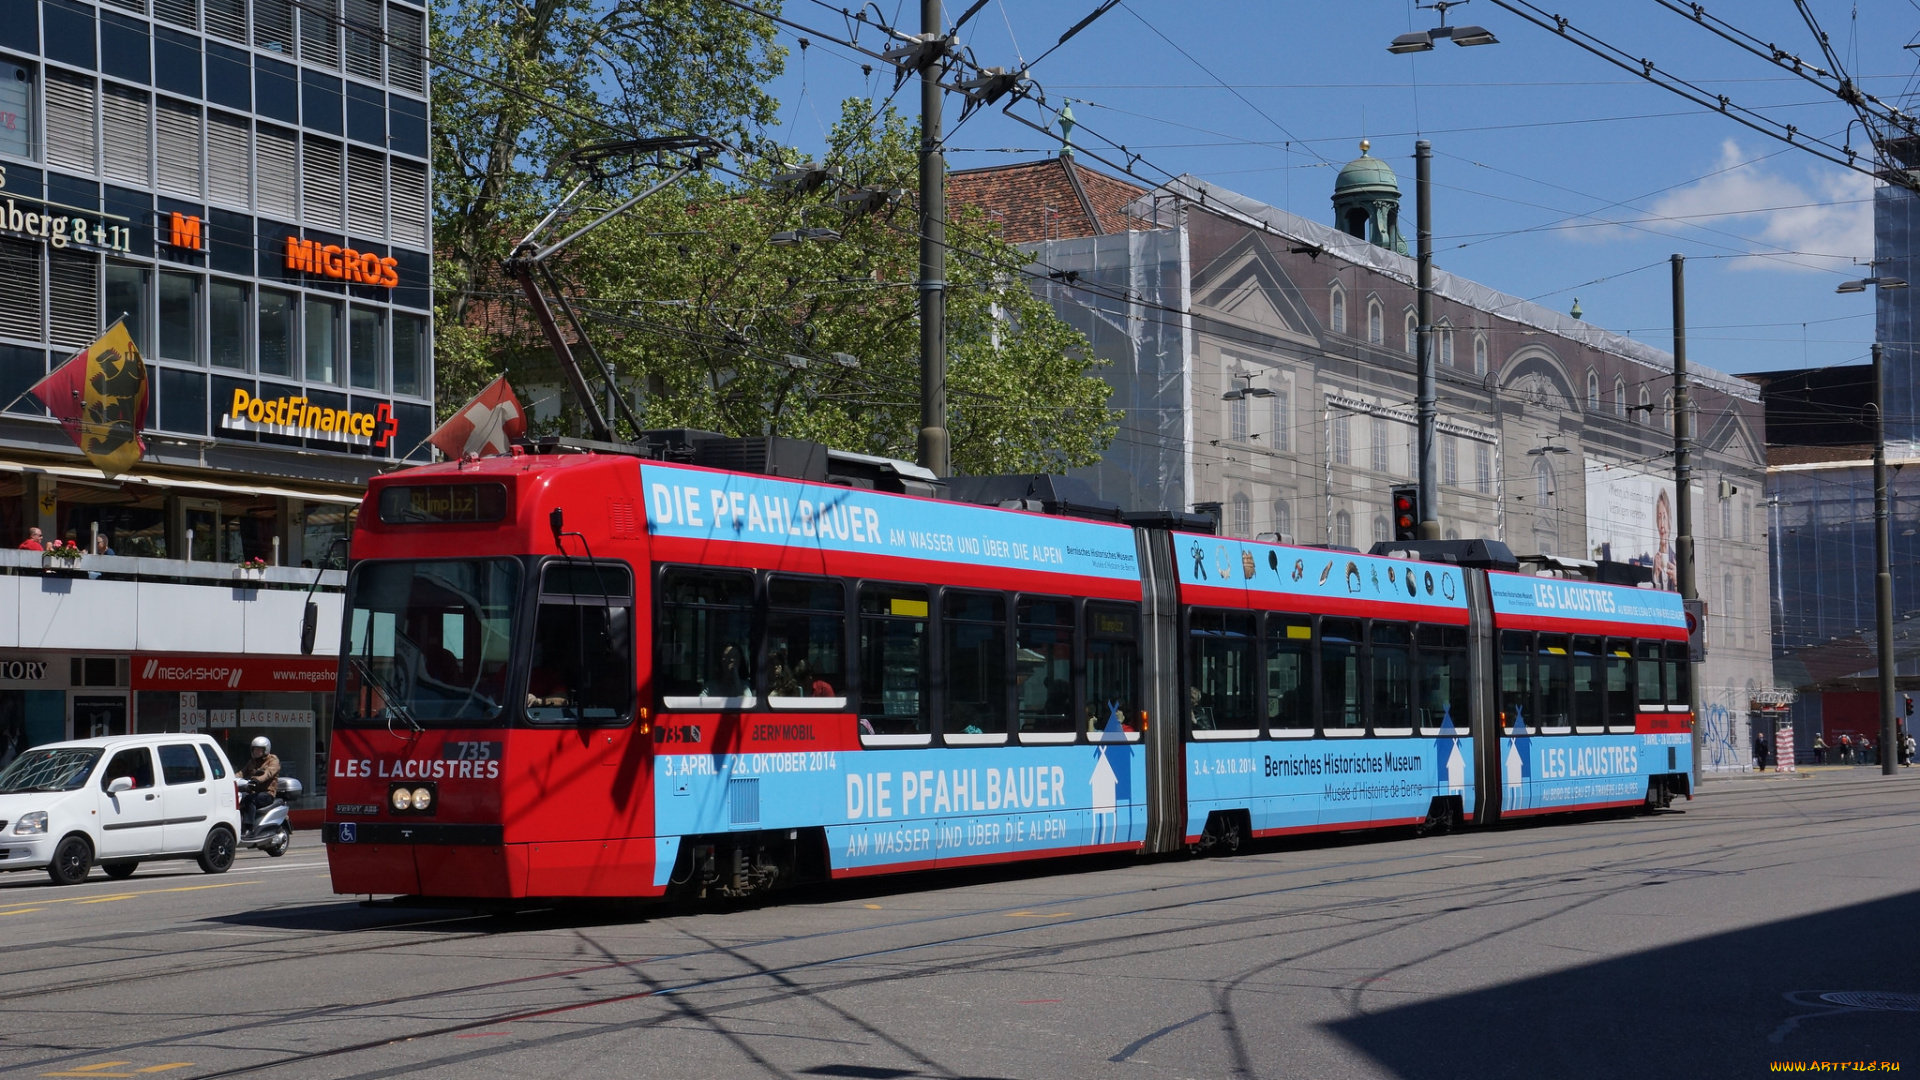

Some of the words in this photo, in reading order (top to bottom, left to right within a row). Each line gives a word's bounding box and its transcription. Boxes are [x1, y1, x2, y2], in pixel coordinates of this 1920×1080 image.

[71, 218, 87, 244] 8
[108, 225, 131, 252] 11
[171, 212, 200, 250] M
[286, 236, 399, 289] MIGROS
[232, 388, 376, 437] PostFinance
[652, 483, 703, 527] DIE
[710, 489, 882, 544] PFAHLBAUER
[889, 528, 906, 547] AM
[909, 531, 955, 552] WASSER
[957, 536, 980, 555] UND
[982, 536, 1010, 559] ÜBER
[1012, 543, 1030, 561] DIE
[1033, 546, 1063, 565] ALPEN
[1066, 545, 1091, 557] Bernisches
[1091, 549, 1117, 560] Historisches
[1117, 551, 1134, 562] Museum
[1533, 583, 1556, 609] LES
[1557, 586, 1616, 614] LACUSTRES
[158, 667, 230, 681] MEGA-SHOP
[181, 695, 197, 708] 50
[212, 712, 235, 724] AUF
[242, 711, 312, 724] LAGERWARE
[661, 725, 684, 743] 735
[457, 741, 491, 760] 735
[665, 756, 677, 776] 3.
[680, 755, 719, 776] APRIL
[731, 754, 750, 775] 26.
[752, 753, 807, 774] OKTOBER
[809, 751, 837, 771] 2014
[1541, 748, 1566, 779] LES
[1569, 746, 1638, 777] LACUSTRES
[334, 759, 372, 778] LES
[378, 759, 500, 778] LACUSTRES
[1239, 758, 1257, 774] 2014
[1264, 753, 1322, 777] Bernisches
[1324, 753, 1382, 775] Historisches
[1384, 751, 1422, 772] Museum
[846, 772, 892, 819] DIE
[902, 766, 1065, 816] PFAHLBAUER
[1324, 782, 1351, 802] Musée
[1352, 780, 1389, 801] d'Histoire
[1390, 780, 1399, 798] de
[1400, 779, 1423, 798] Berne
[846, 833, 869, 857] AM
[874, 828, 930, 854] WASSER
[936, 826, 962, 849] UND
[967, 819, 1000, 847] ÜBER
[1005, 822, 1024, 843] DIE
[1028, 819, 1066, 842] ALPEN
